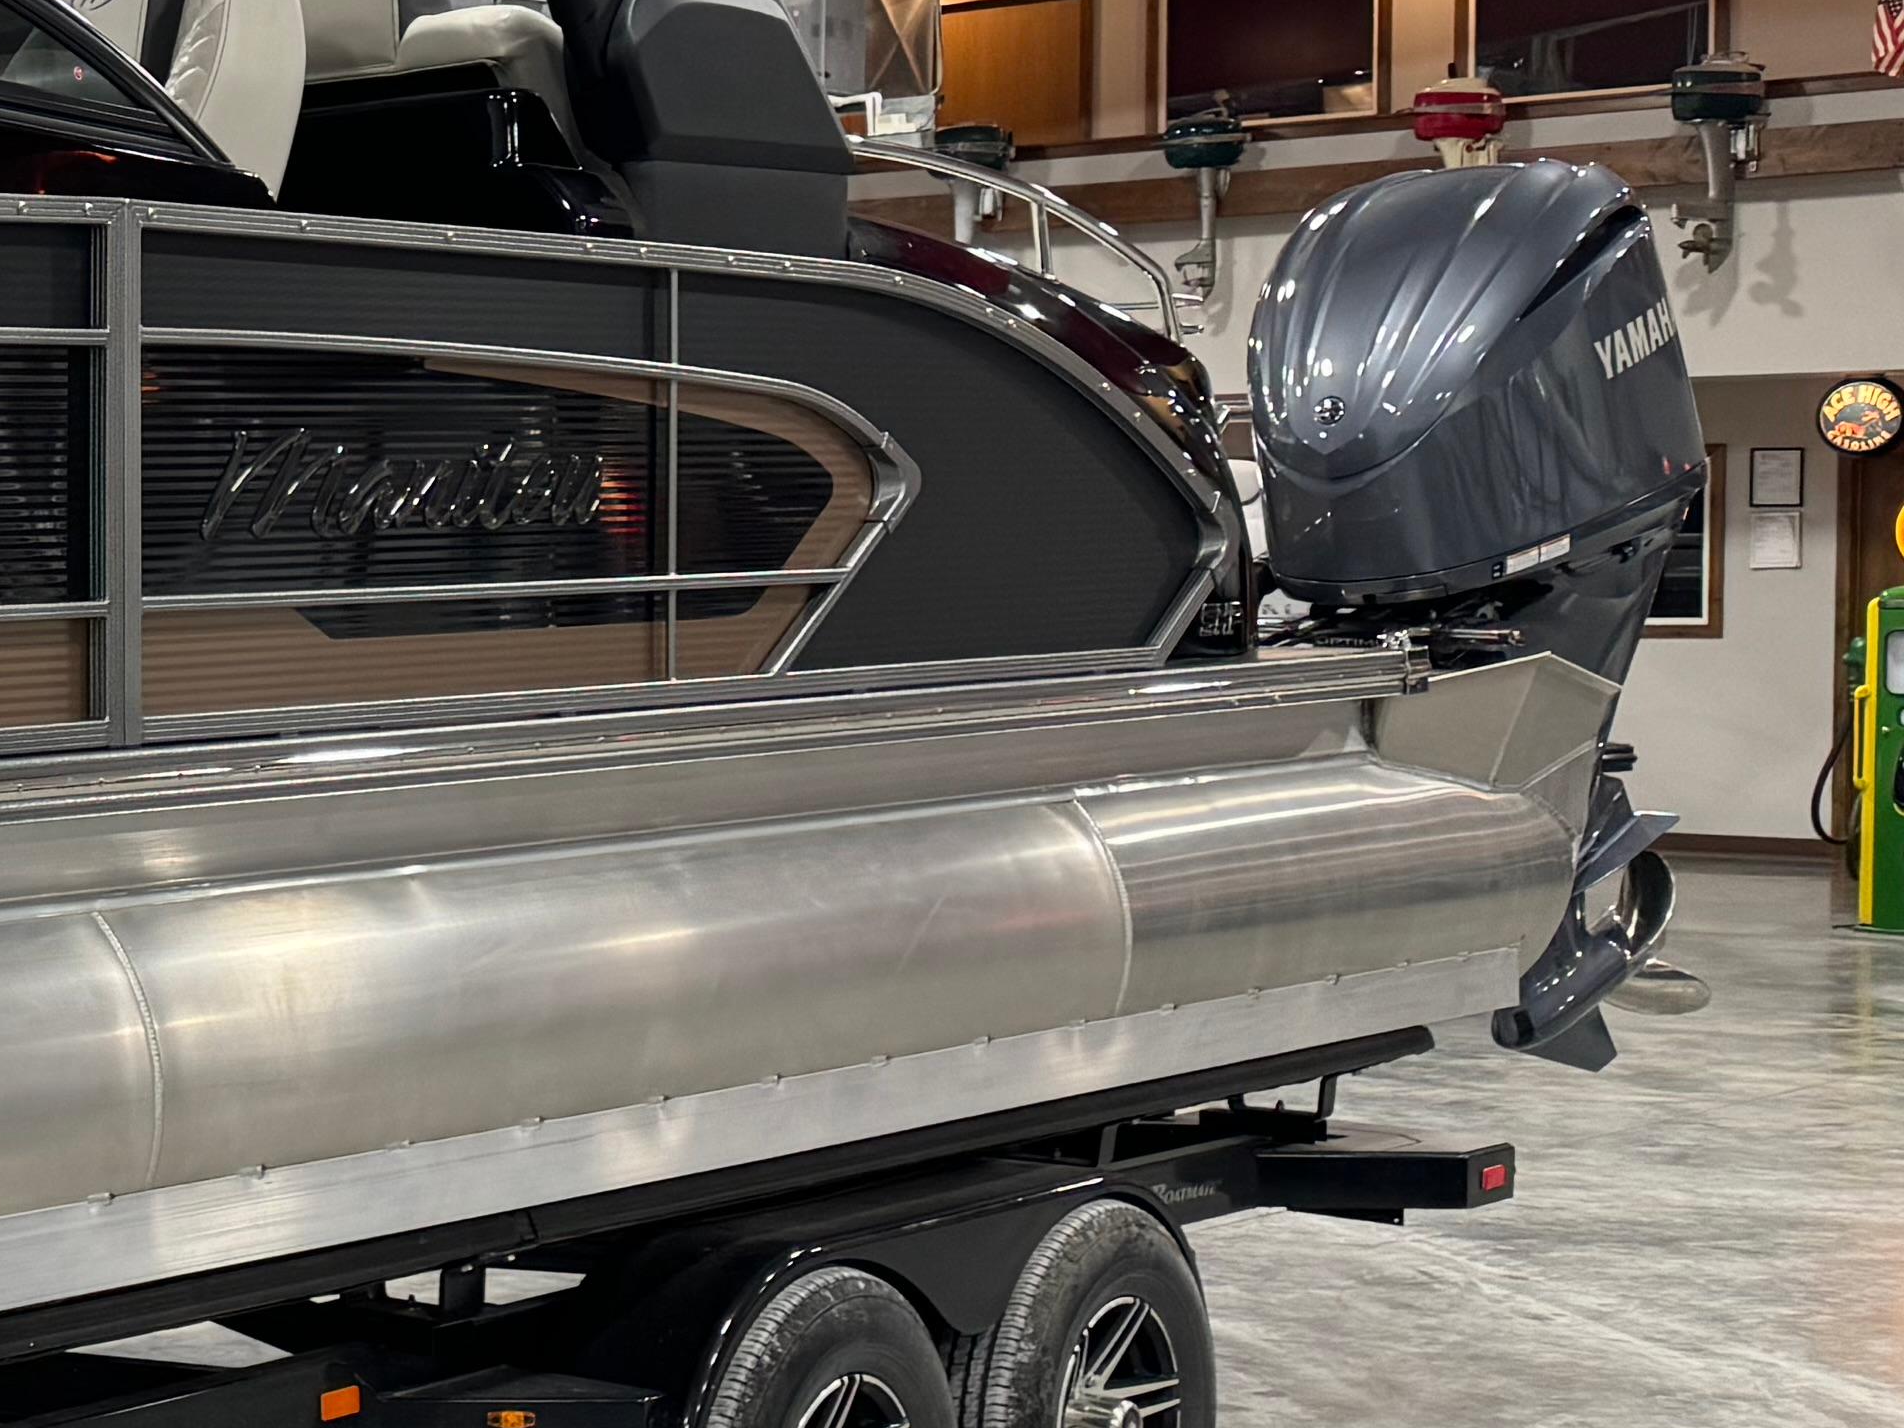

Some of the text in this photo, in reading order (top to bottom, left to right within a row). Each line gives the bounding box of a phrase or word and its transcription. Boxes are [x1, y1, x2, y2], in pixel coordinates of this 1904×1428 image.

[1593, 297, 1674, 380] YAMAH
[1822, 383, 1902, 423] ACE HIGH
[1827, 429, 1892, 452] GASOLINE
[199, 427, 604, 541] Manitou
